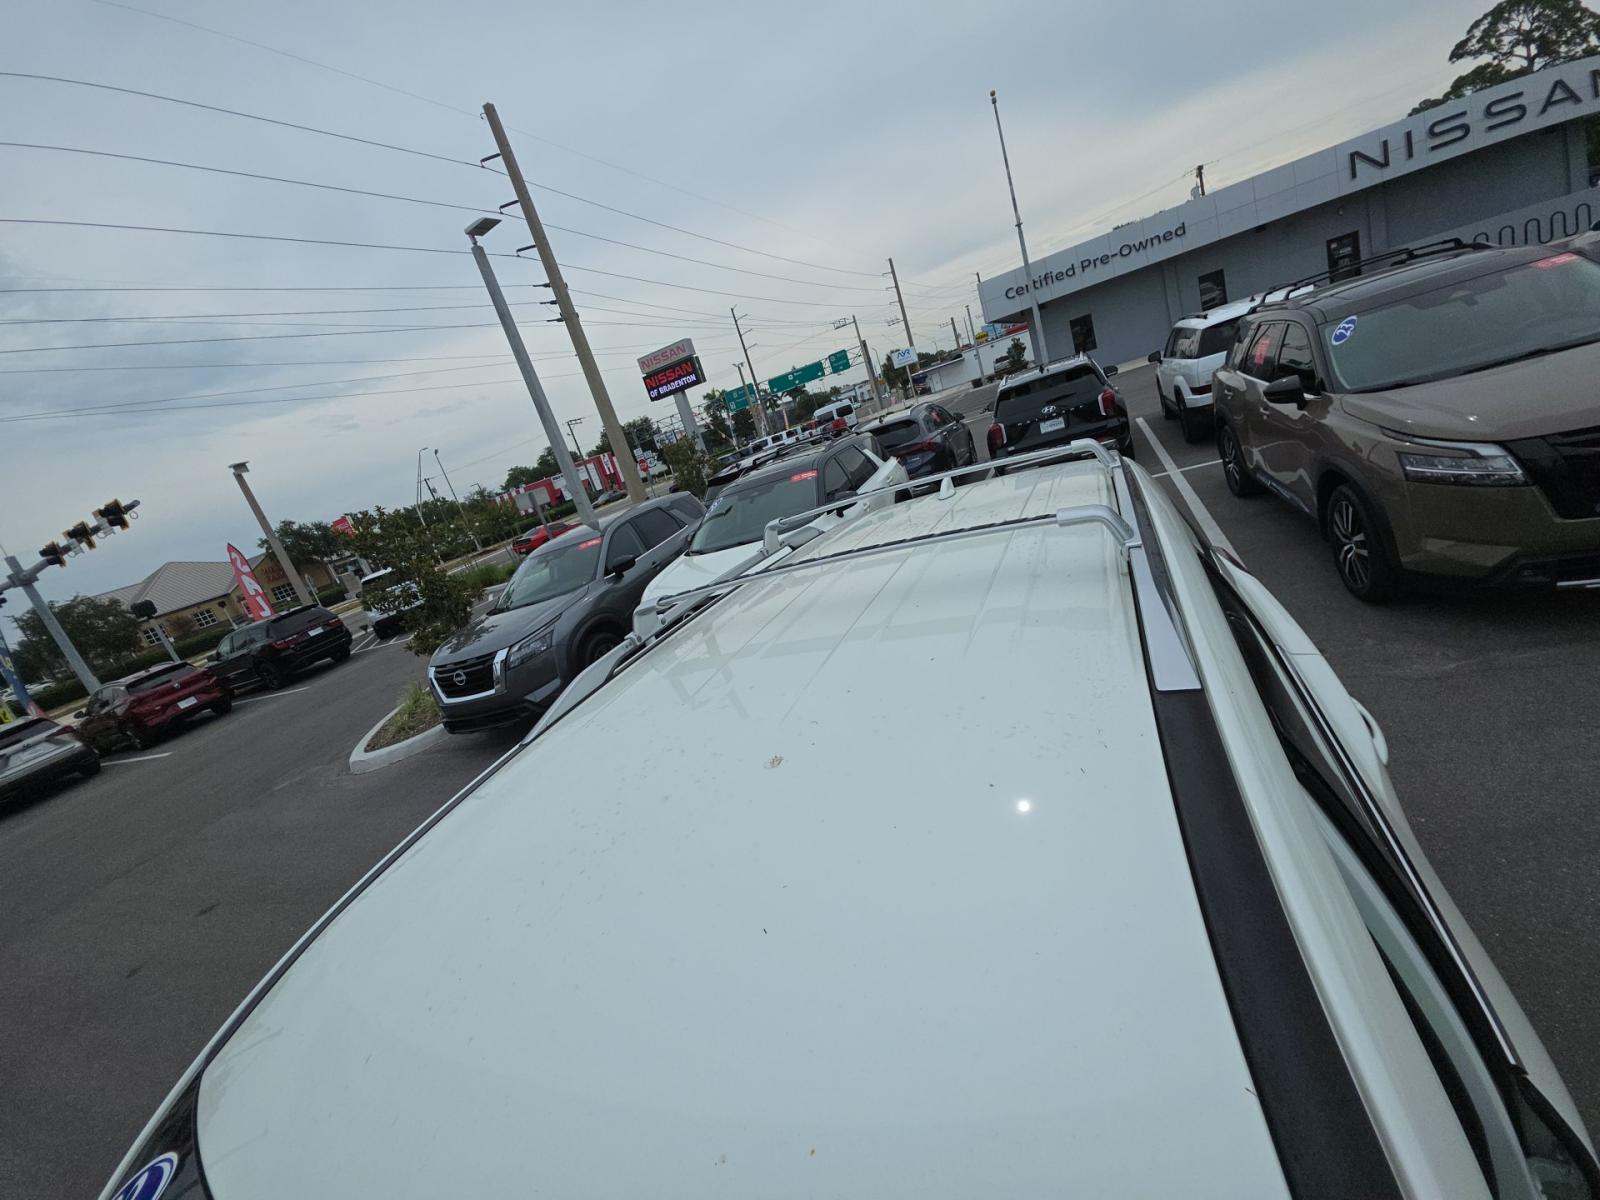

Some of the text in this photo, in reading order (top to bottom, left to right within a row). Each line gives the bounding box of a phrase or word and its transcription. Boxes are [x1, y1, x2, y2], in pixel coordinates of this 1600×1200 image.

[1005, 222, 1186, 300] Certified Pre-Owned
[640, 343, 686, 369] NISSAN
[645, 361, 693, 388] NISSAN
[650, 374, 697, 398] OF BRADENTON
